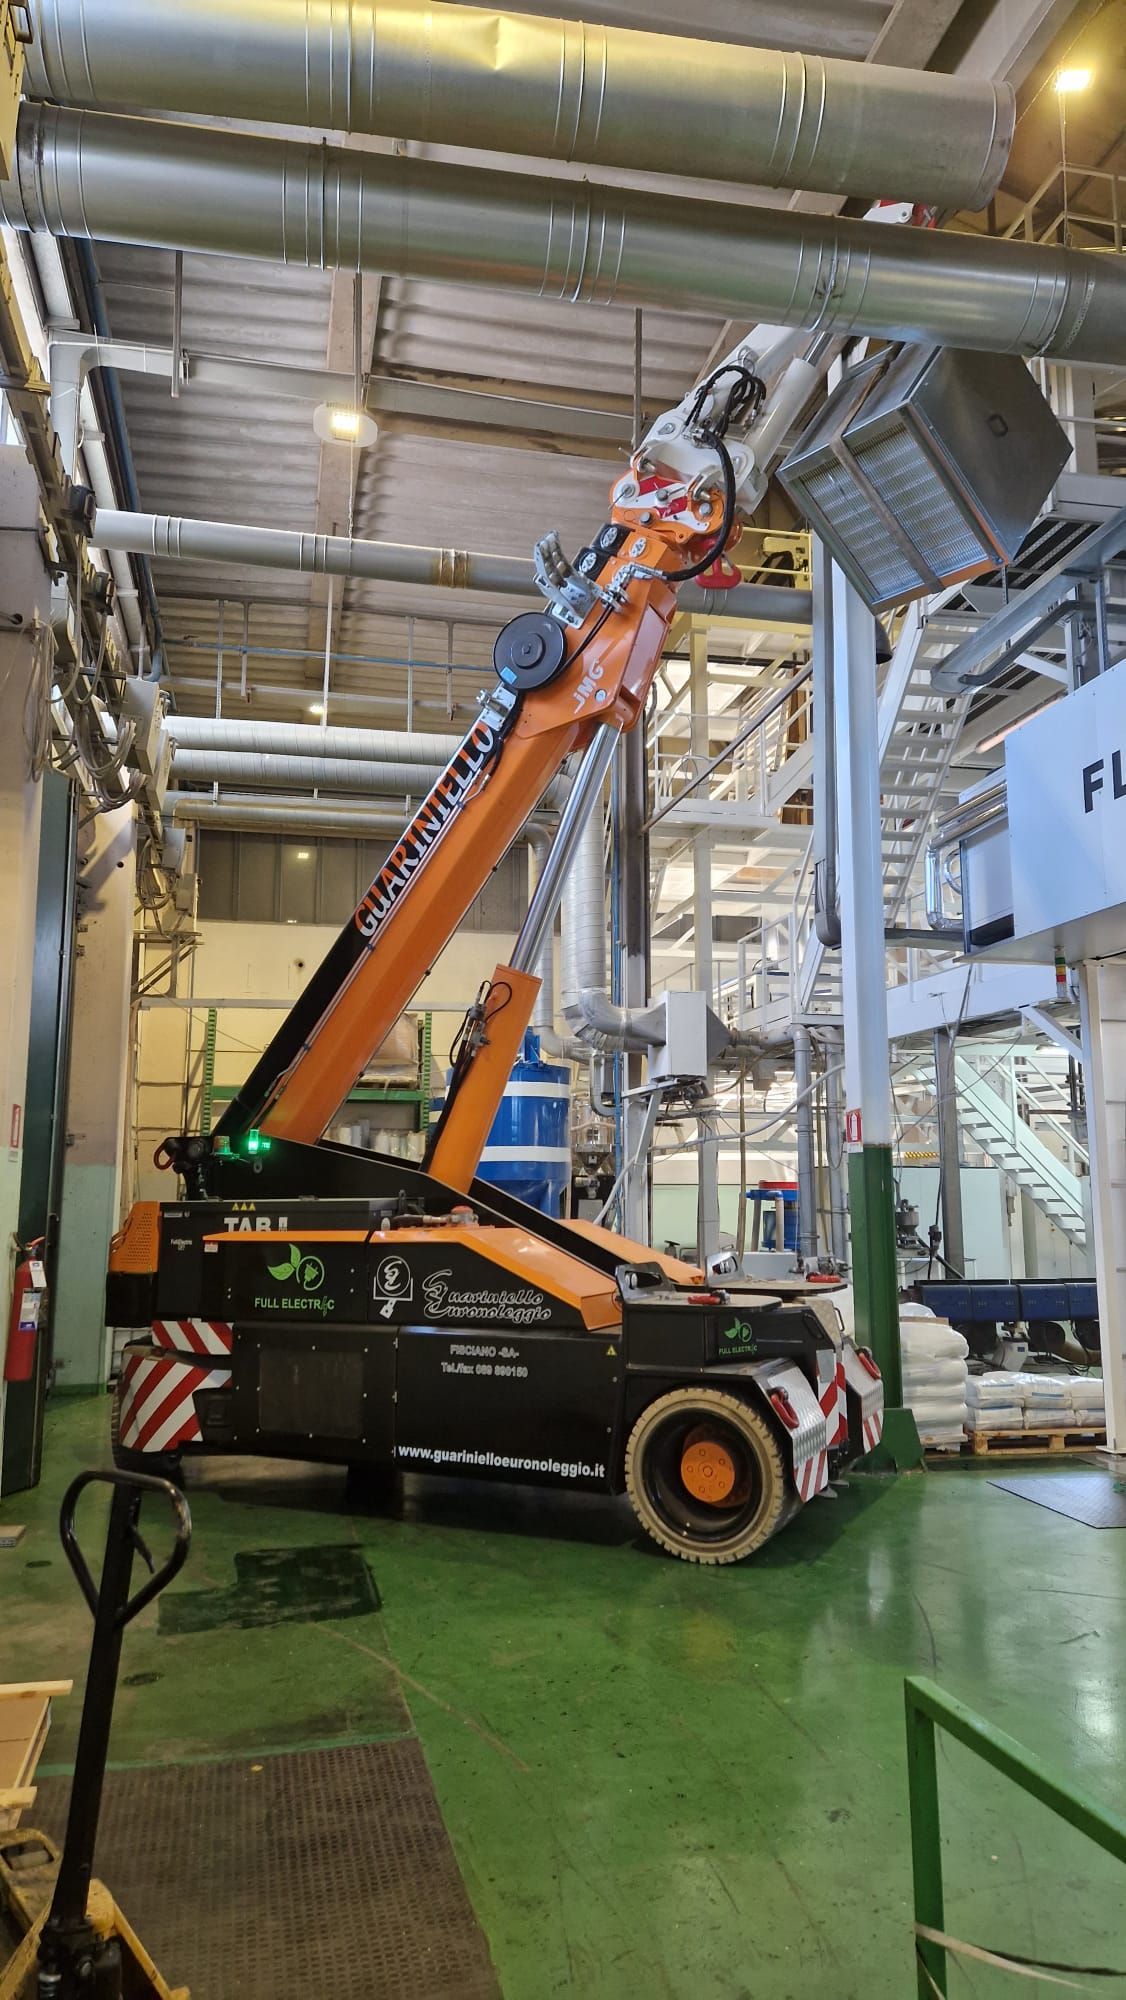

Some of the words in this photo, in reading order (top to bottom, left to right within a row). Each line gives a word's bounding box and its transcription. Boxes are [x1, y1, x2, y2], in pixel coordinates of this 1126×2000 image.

[354, 721, 494, 937] GUARINIELLO
[254, 1298, 280, 1308] FULL
[398, 1445, 605, 1479] www.guarinielloeuronoleggio.it
